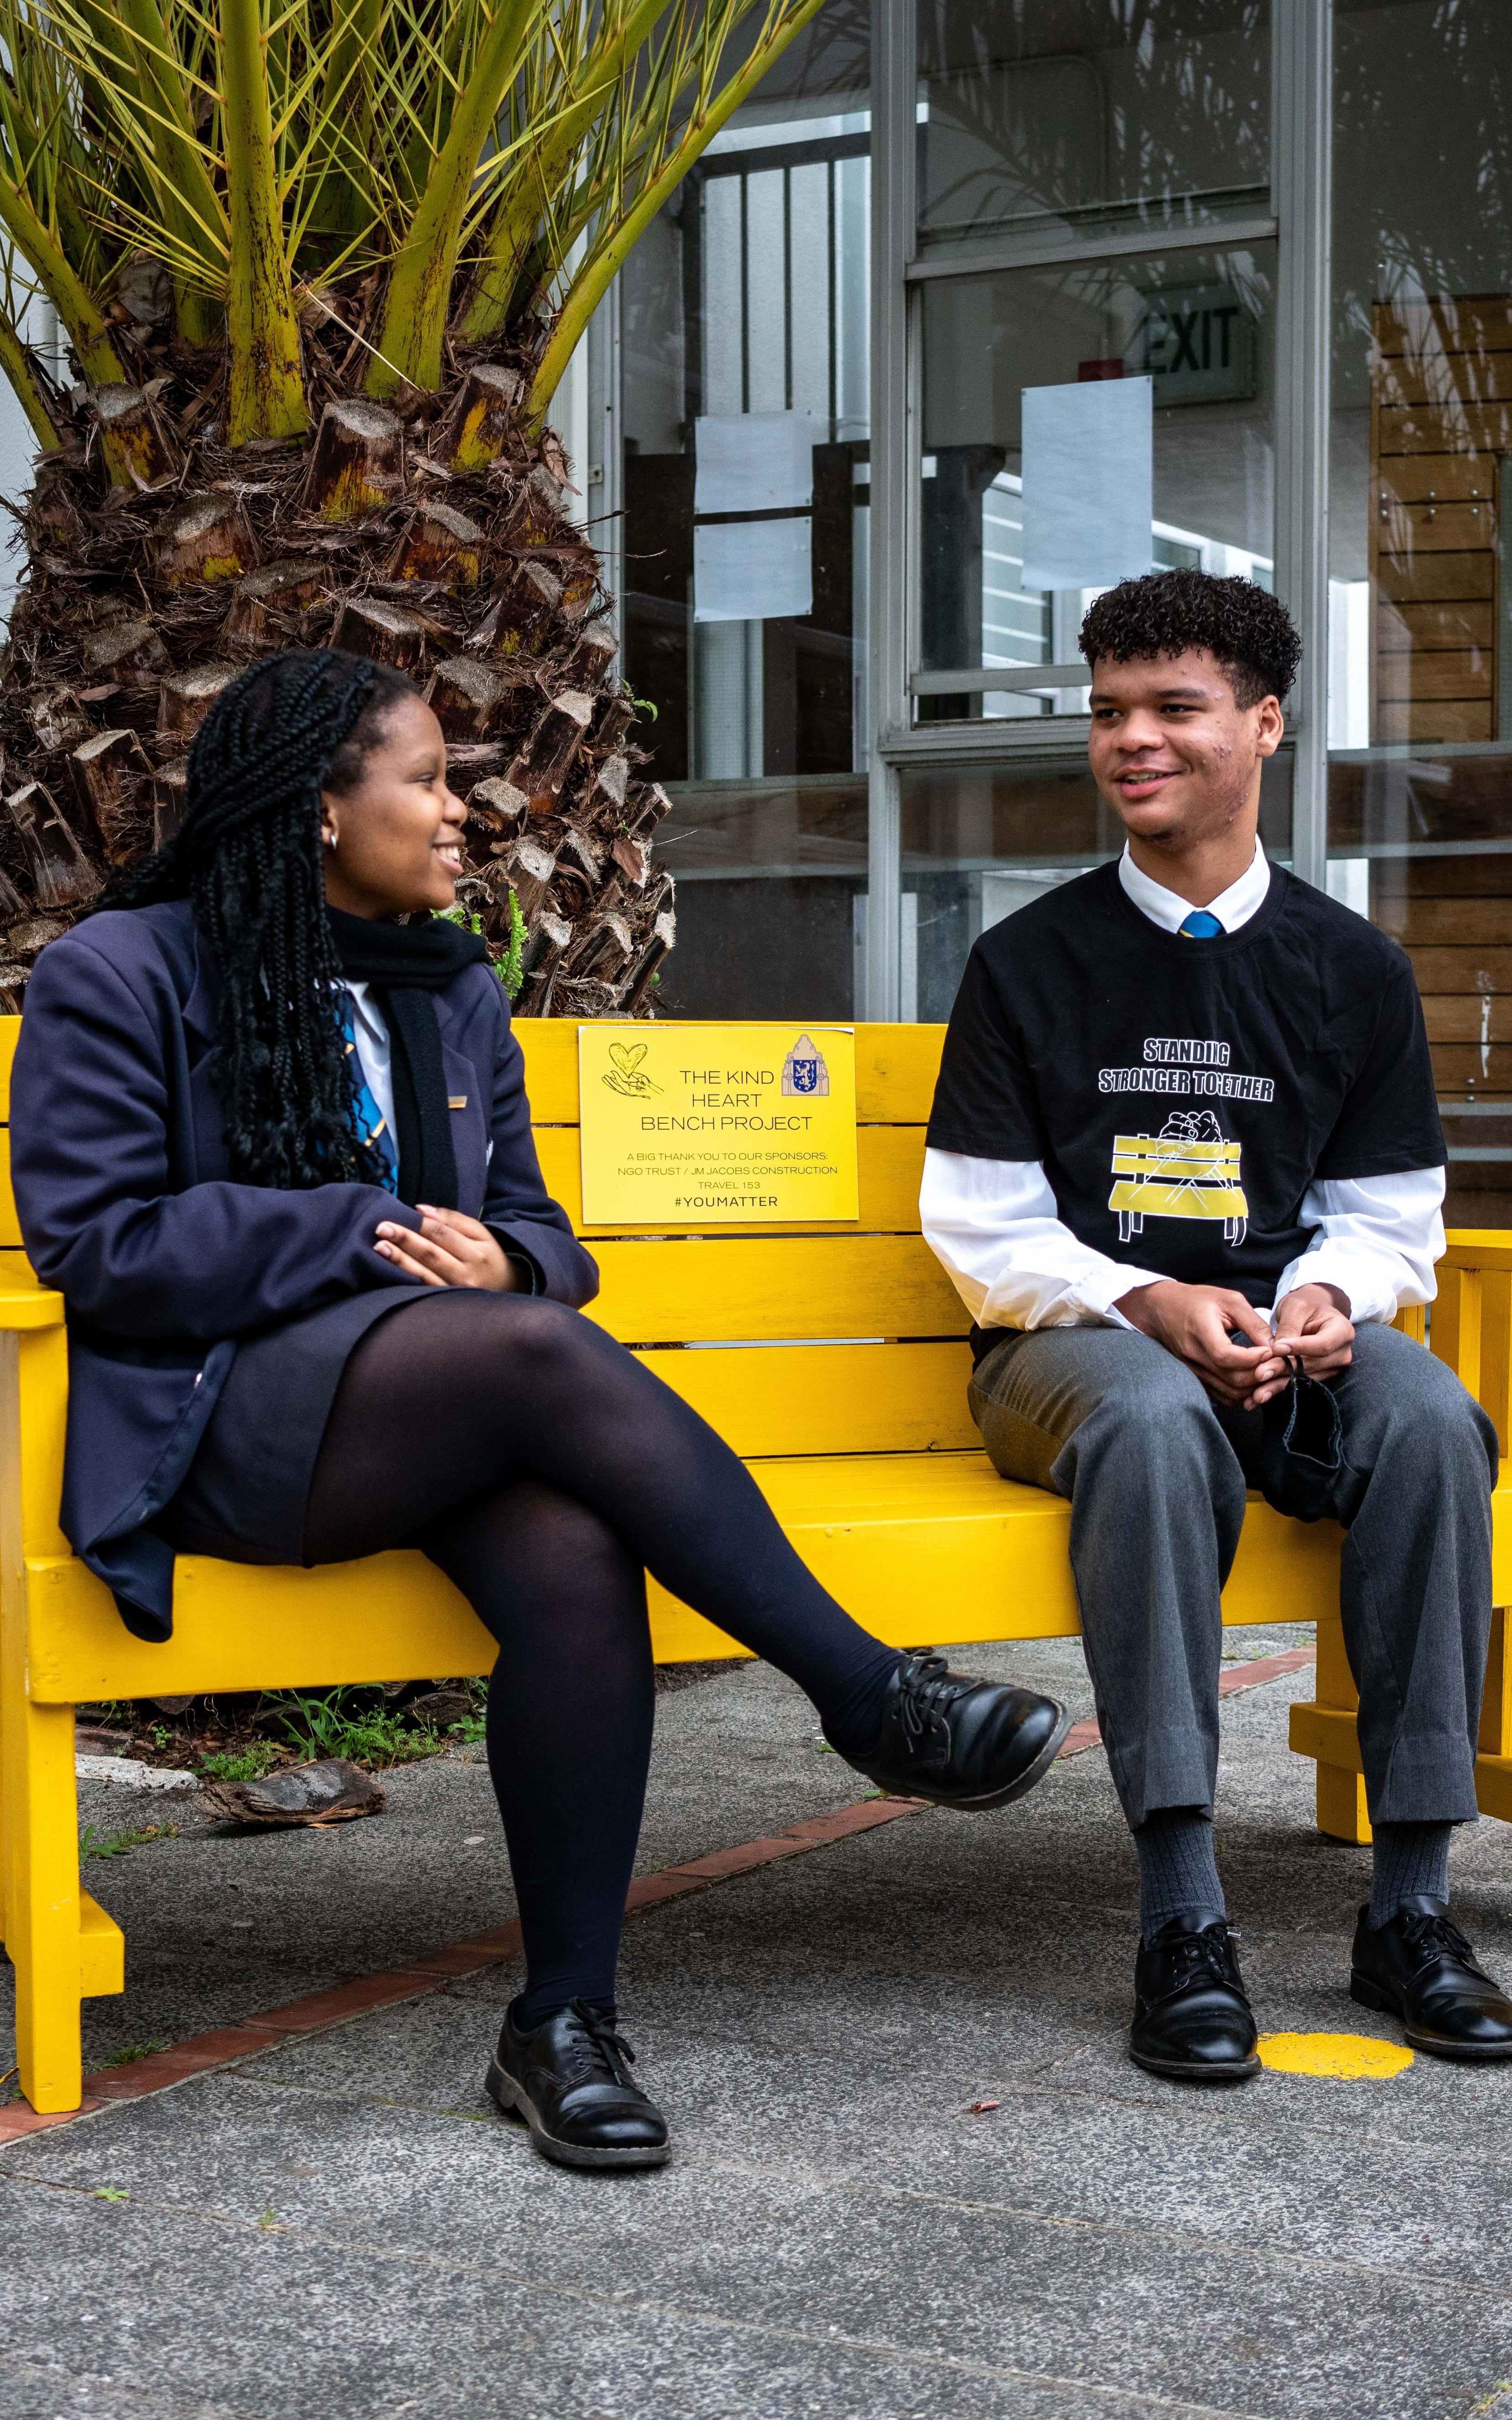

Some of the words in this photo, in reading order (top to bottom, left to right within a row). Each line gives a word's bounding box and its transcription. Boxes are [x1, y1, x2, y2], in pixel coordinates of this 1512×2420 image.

[1143, 307, 1240, 375] EXIT
[679, 1070, 721, 1084] THE
[727, 1071, 774, 1085] KIND
[1099, 1068, 1190, 1093] STRONGER
[692, 1094, 762, 1107] HEART
[641, 1116, 715, 1131] BENCH
[721, 1116, 812, 1131] PROJECT
[707, 1167, 750, 1175] JACOBS
[753, 1166, 837, 1175] CONSTRUCTION
[675, 1196, 778, 1207] #YOUMATTER
